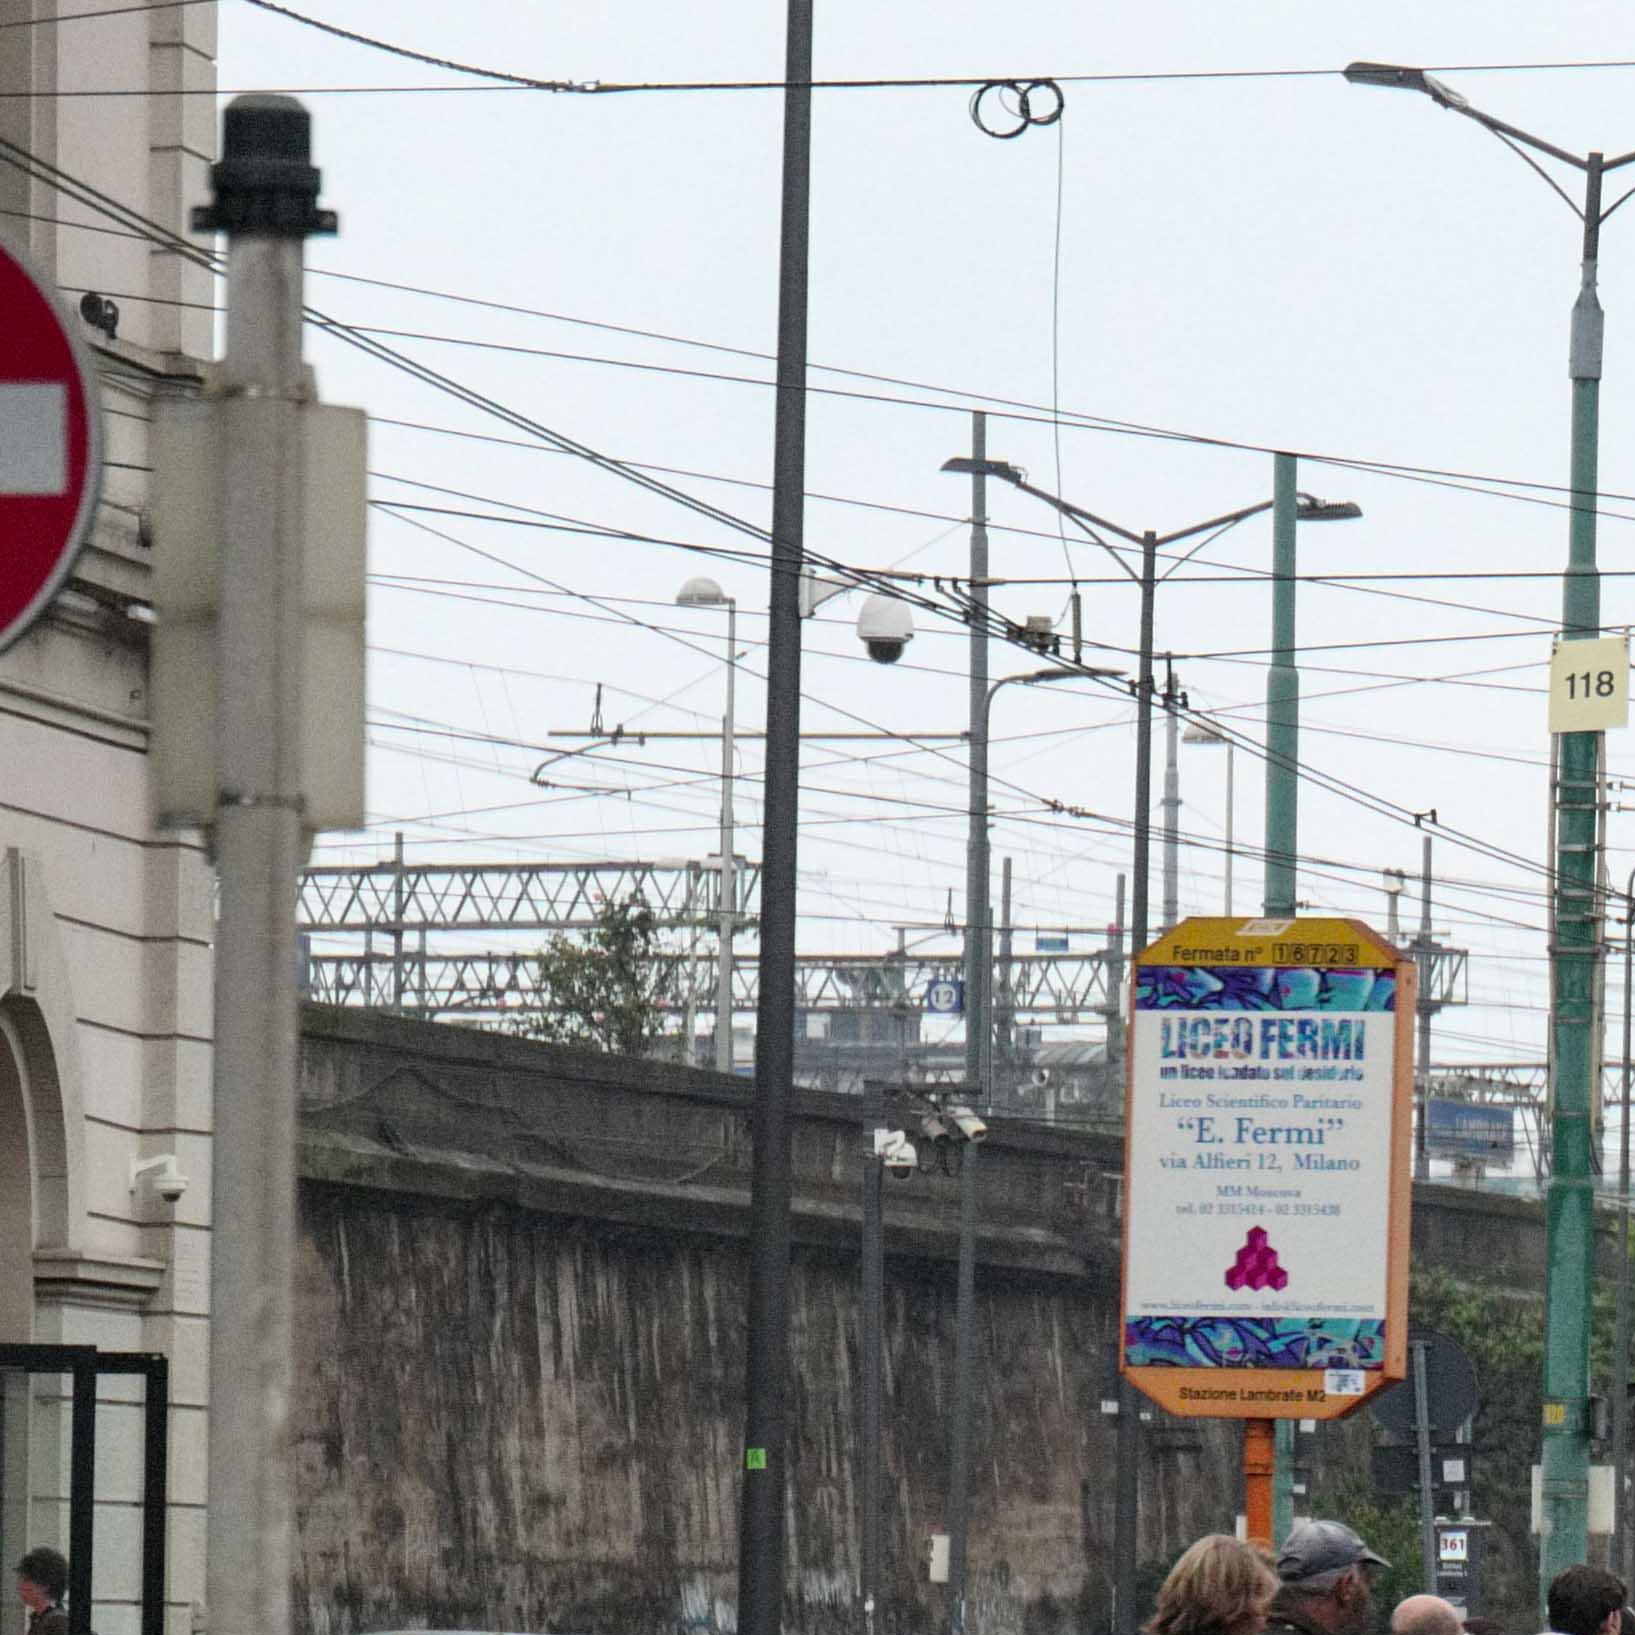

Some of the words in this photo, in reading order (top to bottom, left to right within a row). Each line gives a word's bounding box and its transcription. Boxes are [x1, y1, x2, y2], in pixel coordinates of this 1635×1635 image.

[1565, 670, 1614, 699] 118
[1172, 945, 1239, 962] Fermata
[935, 989, 953, 1004] 12
[1160, 1017, 1253, 1060] LICEO
[1260, 1017, 1366, 1061] FERMI
[1159, 1094, 1201, 1109] Liceo
[1206, 1094, 1288, 1109] Scientifico
[1292, 1094, 1362, 1110] Paritario
[1160, 1153, 1187, 1169] via
[1192, 1153, 1250, 1170] Alfieri
[1258, 1153, 1282, 1173] 12,
[1293, 1153, 1360, 1171] Milano
[1179, 1386, 1237, 1401] Stazione
[1240, 1387, 1303, 1402] Lambrate
[1307, 1389, 1327, 1403] M2
[1441, 1537, 1465, 1552] 361
